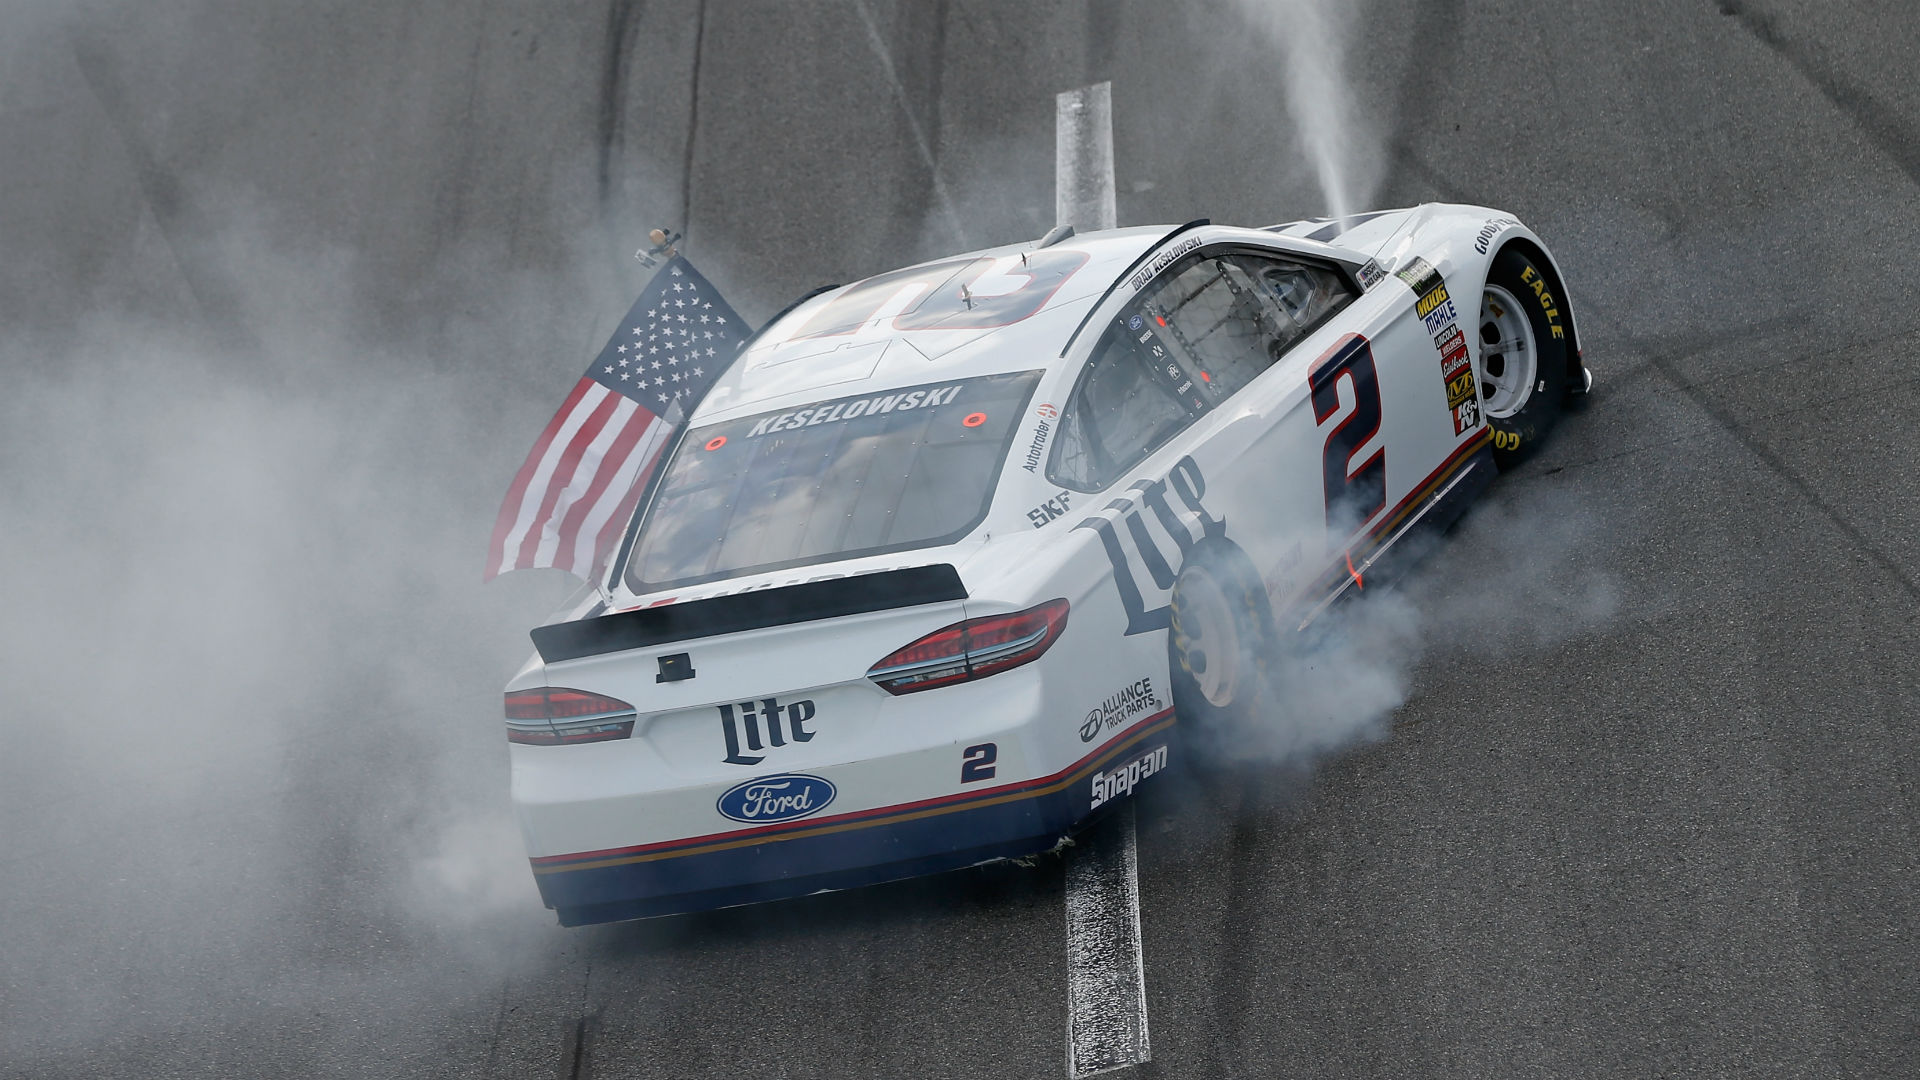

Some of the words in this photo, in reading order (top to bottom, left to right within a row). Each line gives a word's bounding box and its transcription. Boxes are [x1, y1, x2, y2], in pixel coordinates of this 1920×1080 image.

[1131, 267, 1153, 292] BRAD
[1152, 235, 1203, 273] KESELOWSKI
[1417, 283, 1447, 318] MOOG
[1425, 300, 1457, 336] MAHLE
[1521, 265, 1564, 340] EAGLE
[1435, 324, 1457, 349] LINCOLN
[746, 385, 963, 438] KESELOWSKI
[1022, 419, 1050, 474] Autotrader
[1308, 332, 1387, 555] 2
[1027, 490, 1070, 529] SKF
[1102, 677, 1153, 718] ALLIANCE
[1104, 708, 1127, 730] TRUCK
[1127, 693, 1155, 717] PARTS
[716, 697, 817, 766] Lite
[960, 742, 998, 784] 2
[1090, 745, 1168, 811] Snap-on
[742, 781, 813, 818] Ford
